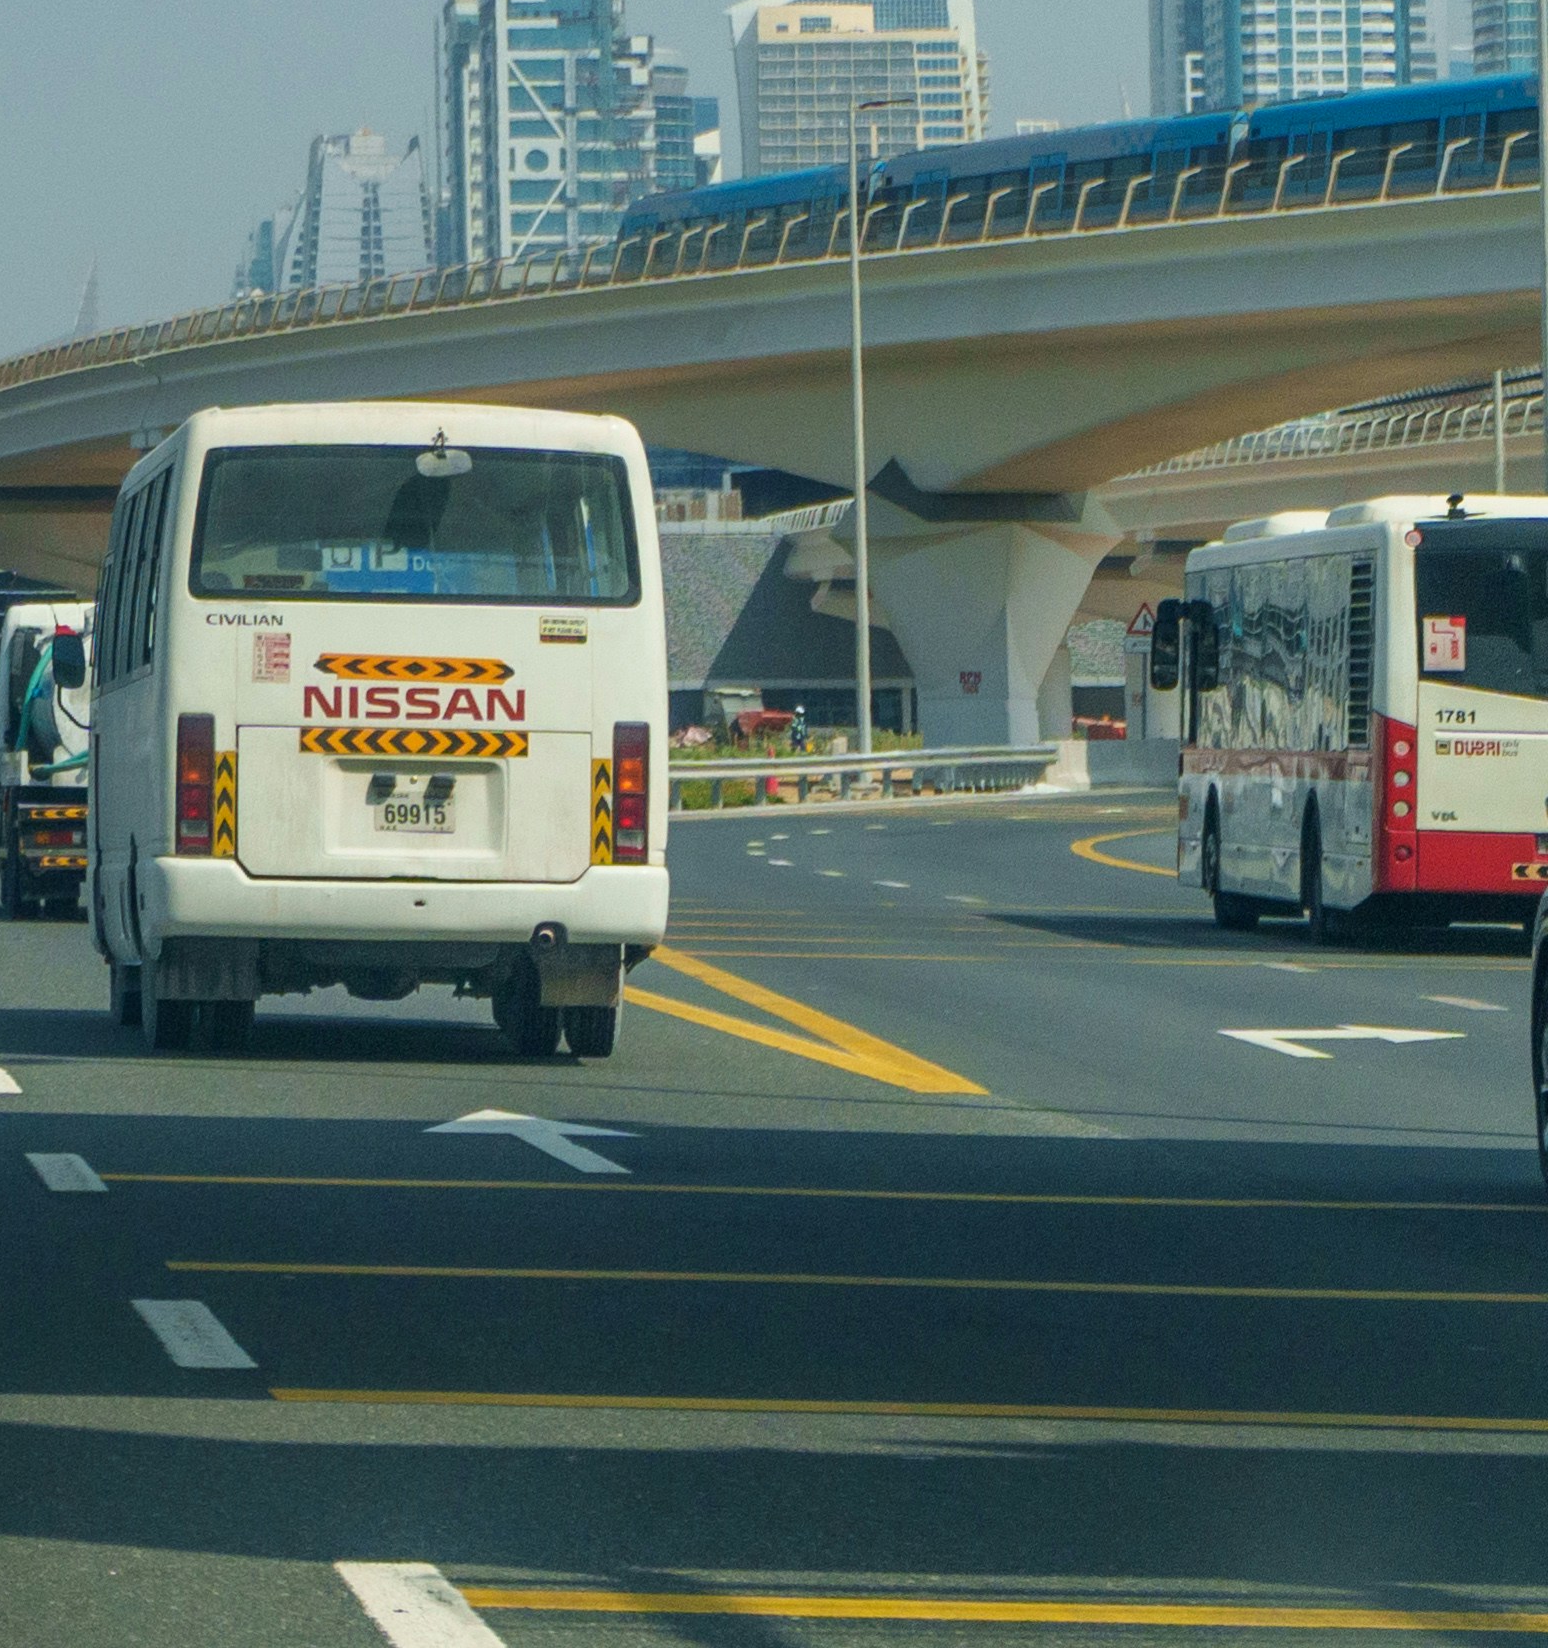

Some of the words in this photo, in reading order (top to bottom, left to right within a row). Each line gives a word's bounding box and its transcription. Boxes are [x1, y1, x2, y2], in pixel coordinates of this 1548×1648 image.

[206, 613, 284, 626] CIVILIAN
[303, 685, 526, 722] NISSAN
[1435, 710, 1476, 724] 1781
[385, 804, 446, 825] 69915
